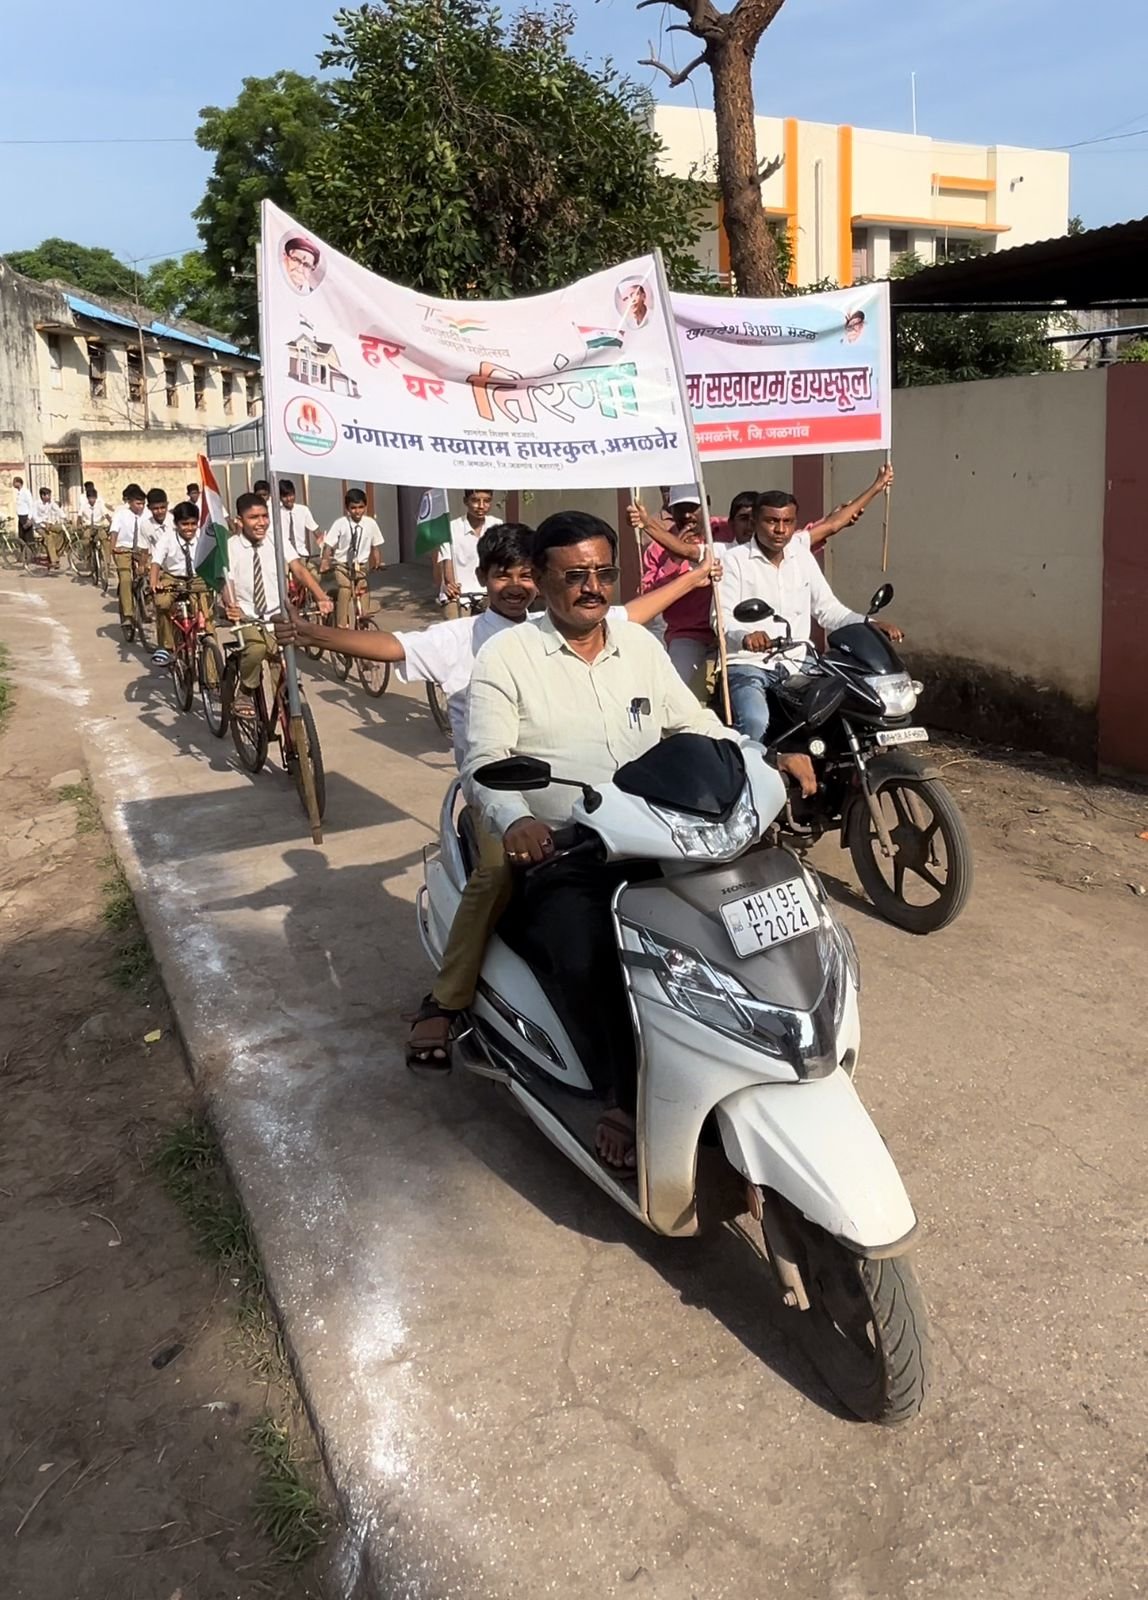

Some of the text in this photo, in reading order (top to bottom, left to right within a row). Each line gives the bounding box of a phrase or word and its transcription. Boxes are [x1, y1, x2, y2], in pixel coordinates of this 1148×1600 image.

[742, 321, 782, 337] शिक्षण
[358, 334, 406, 369] हर
[402, 373, 449, 404] घर
[705, 371, 787, 404] सखाराम
[789, 367, 871, 411] हायस्कूल
[342, 418, 424, 451] गंगाराम
[428, 436, 510, 458] सखाराम
[743, 883, 801, 922] MH19E
[752, 907, 810, 947] F2024
